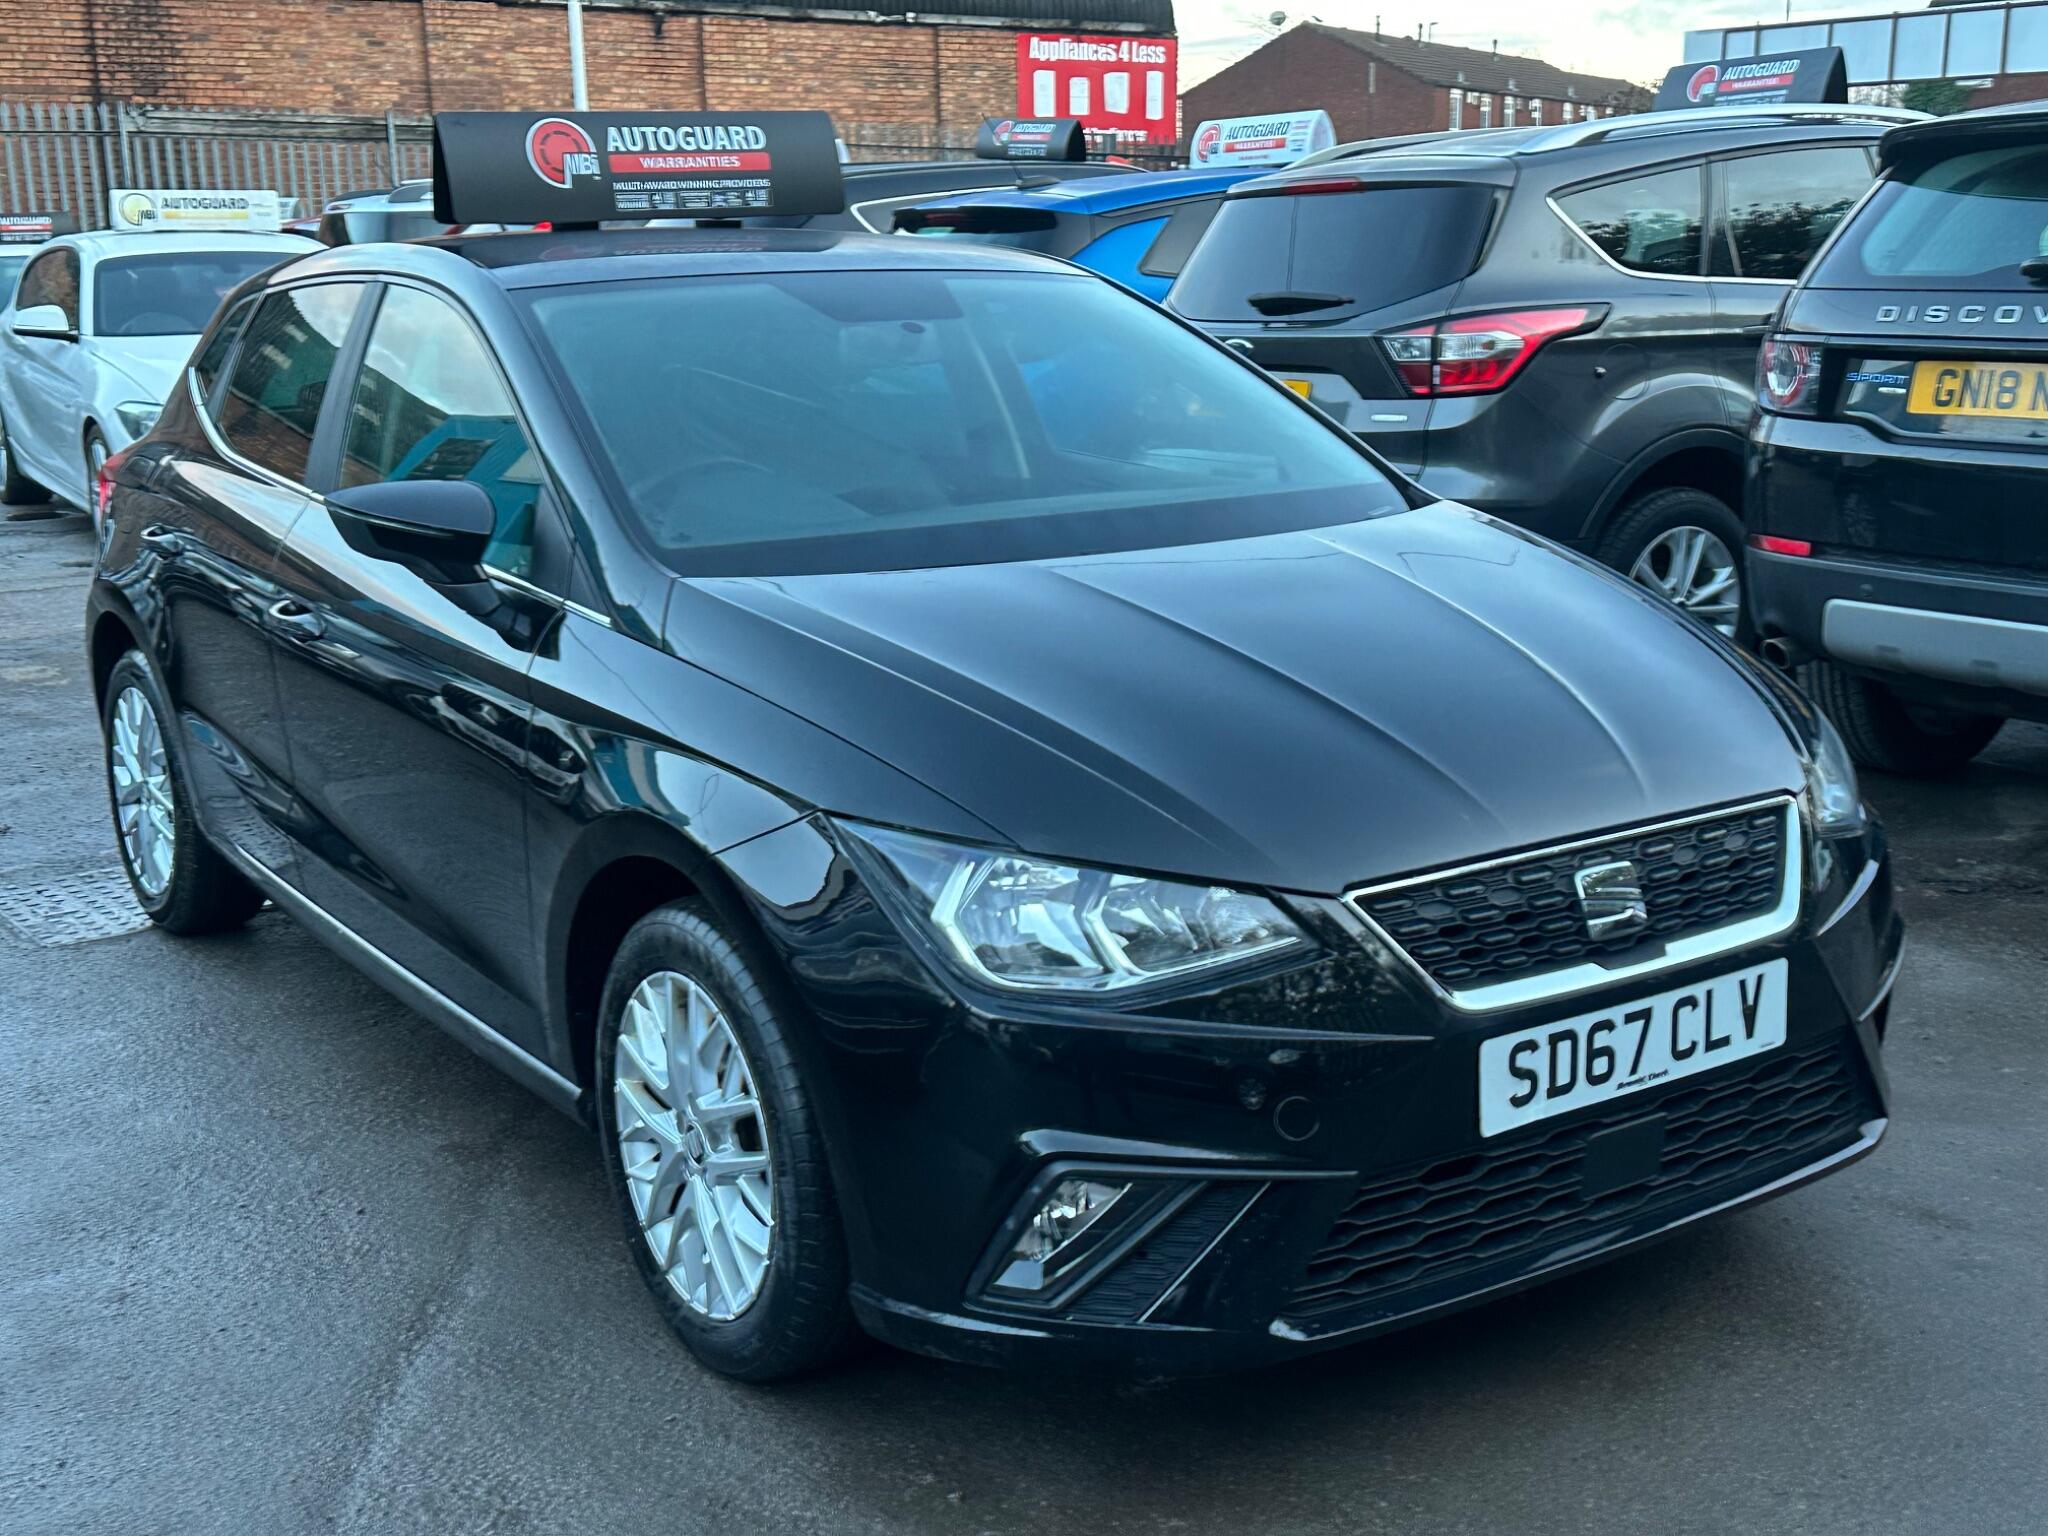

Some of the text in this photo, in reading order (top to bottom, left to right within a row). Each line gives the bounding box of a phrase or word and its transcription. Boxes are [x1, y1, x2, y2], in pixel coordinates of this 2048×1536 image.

[1029, 37, 1166, 64] Appliances 4 Less
[1721, 60, 1800, 80] AUTOGUARD
[607, 126, 767, 152] AUTOGUARD
[1225, 121, 1290, 140] AUTOGUARD
[640, 156, 741, 169] WARRANTIES
[161, 197, 250, 209] AUTOGUARD
[1846, 372, 1909, 385] SPORT
[1932, 368, 2022, 410] GN18
[1508, 973, 1765, 1109] SD67 CLV
